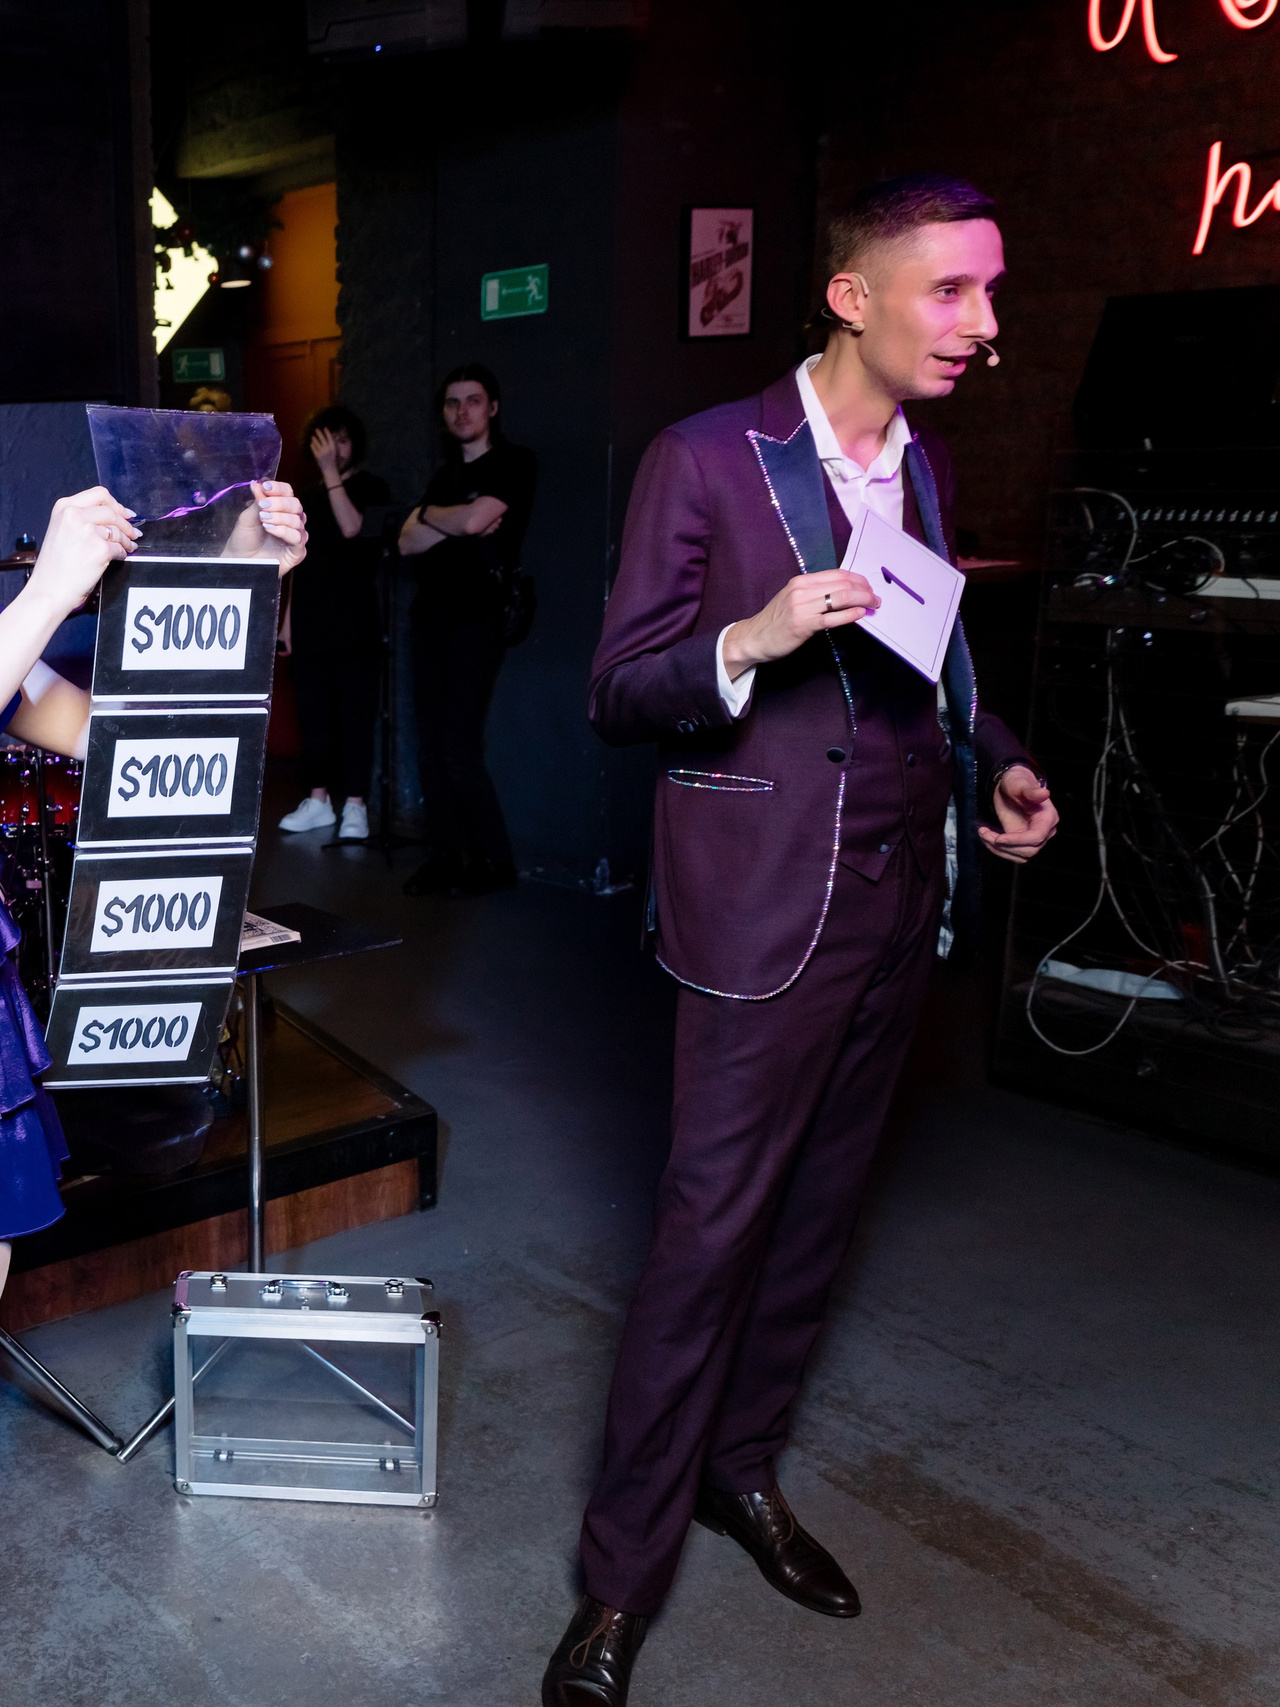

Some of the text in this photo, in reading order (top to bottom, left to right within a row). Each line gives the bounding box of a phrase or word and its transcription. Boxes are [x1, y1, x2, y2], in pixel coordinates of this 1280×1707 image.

[881, 565, 926, 606] 1
[132, 604, 241, 654] $1000
[118, 753, 228, 802] $1000
[101, 892, 212, 938] $1000
[79, 1016, 189, 1054] $1000
